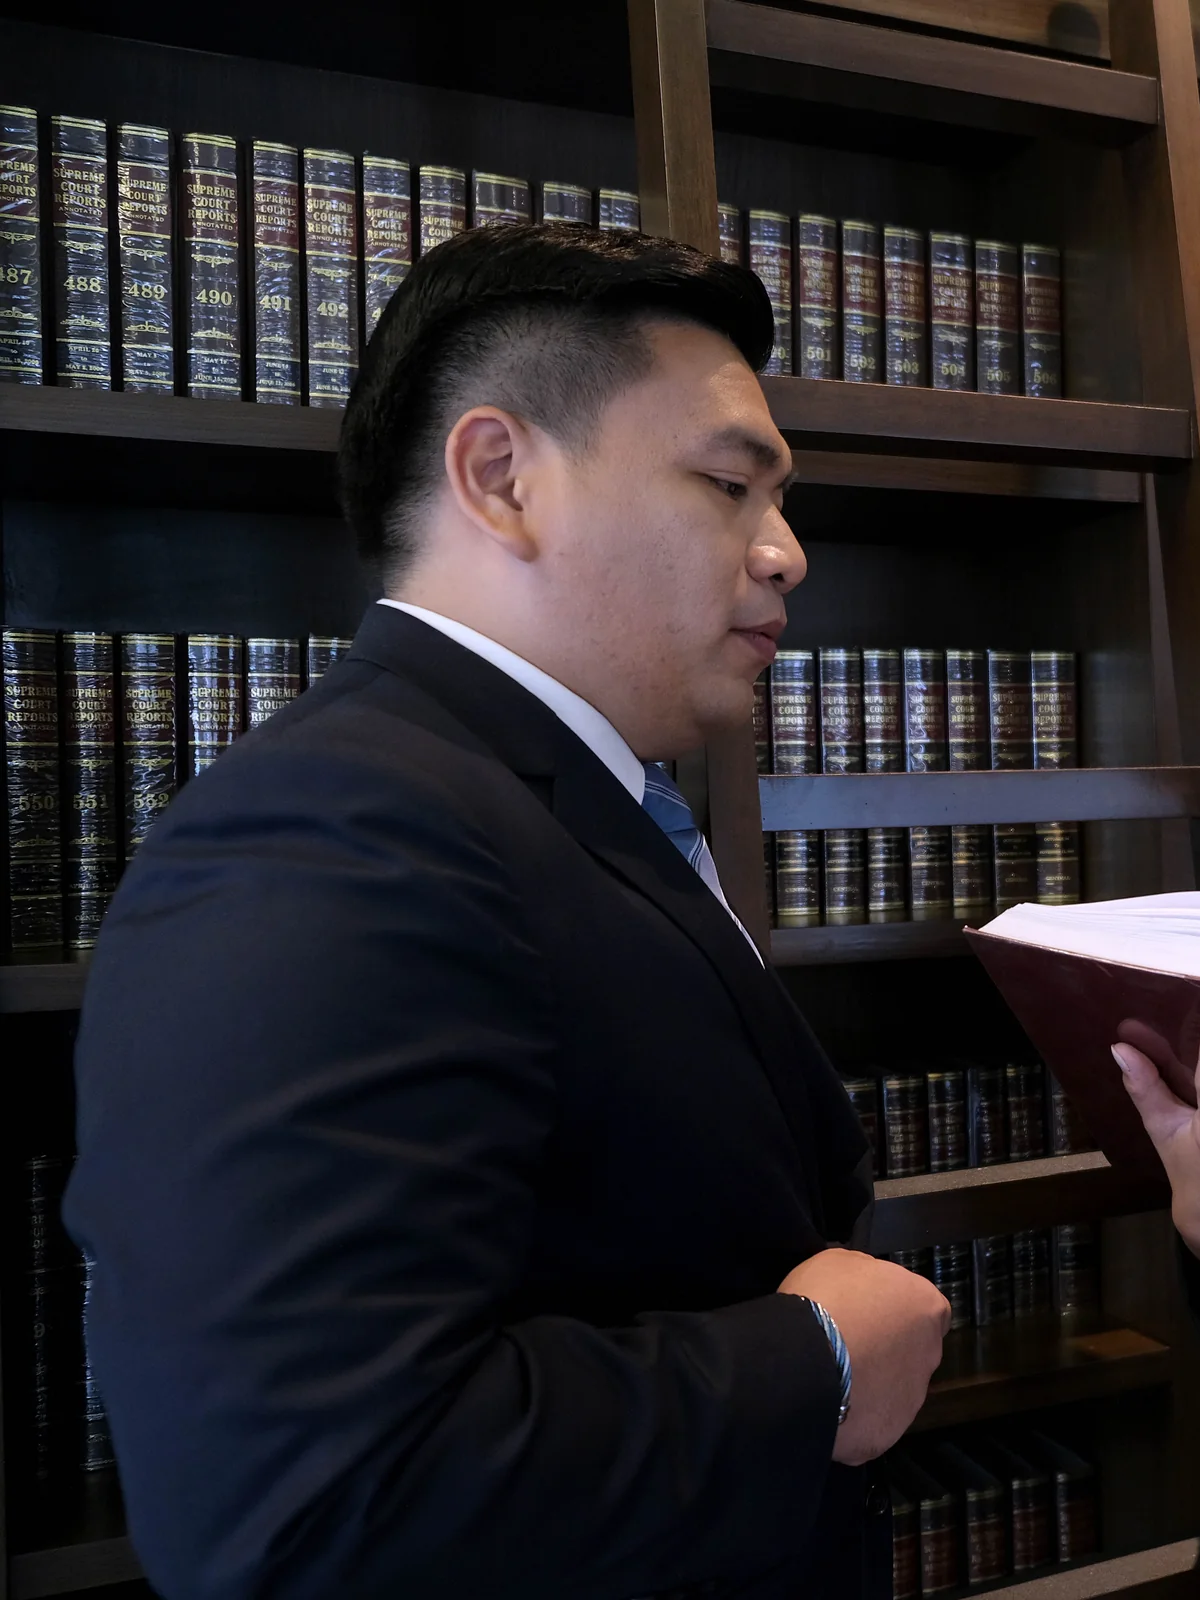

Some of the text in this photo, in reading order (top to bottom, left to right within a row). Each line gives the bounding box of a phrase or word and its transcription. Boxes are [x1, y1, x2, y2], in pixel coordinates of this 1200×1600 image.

[0, 160, 35, 172] PREME
[0, 172, 30, 184] OURT
[53, 168, 106, 184] SUPREME
[0, 184, 36, 197] PORTS
[61, 181, 102, 195] COURT
[121, 178, 167, 192] SUPREME
[186, 184, 236, 199] SUPREME
[54, 192, 107, 209] REPORTS
[127, 190, 162, 203] COURT
[255, 193, 297, 206] SUPREME
[122, 202, 167, 216] REPORTS
[193, 197, 231, 211] COURT
[261, 204, 292, 216] COURT
[306, 198, 353, 214] SUPREME
[58, 206, 103, 216] ANNOTATED
[187, 209, 237, 224] REPORTS
[365, 208, 408, 221] SUPREME
[255, 214, 297, 228] REPORTS
[313, 211, 348, 225] COURT
[423, 216, 464, 230] SUPREME
[192, 221, 233, 231] ANNOTATED
[307, 222, 354, 238] REPORTS
[371, 219, 403, 231] COURT
[366, 229, 408, 242] REPORTS
[63, 275, 103, 293] 488
[128, 283, 165, 300] 489
[195, 289, 232, 306] 490
[260, 294, 291, 311] 491
[316, 302, 349, 318] 492
[807, 345, 831, 361] 501
[850, 354, 876, 370] 502
[894, 359, 919, 374] 503
[987, 368, 1011, 382] 505
[1033, 369, 1057, 384] 506
[6, 686, 57, 697] SUPREME
[66, 688, 112, 698] SUPREME
[125, 689, 172, 698] SUPREME
[191, 688, 240, 699] SUPREME
[250, 688, 297, 698] SUPREME
[13, 699, 52, 709] COURT
[72, 700, 107, 710] COURT
[132, 700, 167, 710] COURT
[198, 700, 234, 710] COURT
[773, 695, 812, 704] SUPREME
[778, 706, 807, 715] COURT
[828, 707, 856, 715] COURT
[869, 705, 894, 713] COURT
[1039, 705, 1067, 713] COURT
[7, 712, 58, 722] REPORTS
[67, 712, 113, 722] REPORTS
[126, 712, 173, 722] REPORTS
[192, 712, 240, 723] REPORTS
[774, 716, 813, 725] REPORTS
[911, 715, 941, 723] REPORT
[1034, 715, 1072, 724] REPORTS
[19, 795, 54, 811] 550
[73, 794, 108, 810] 551
[133, 793, 169, 809] 552
